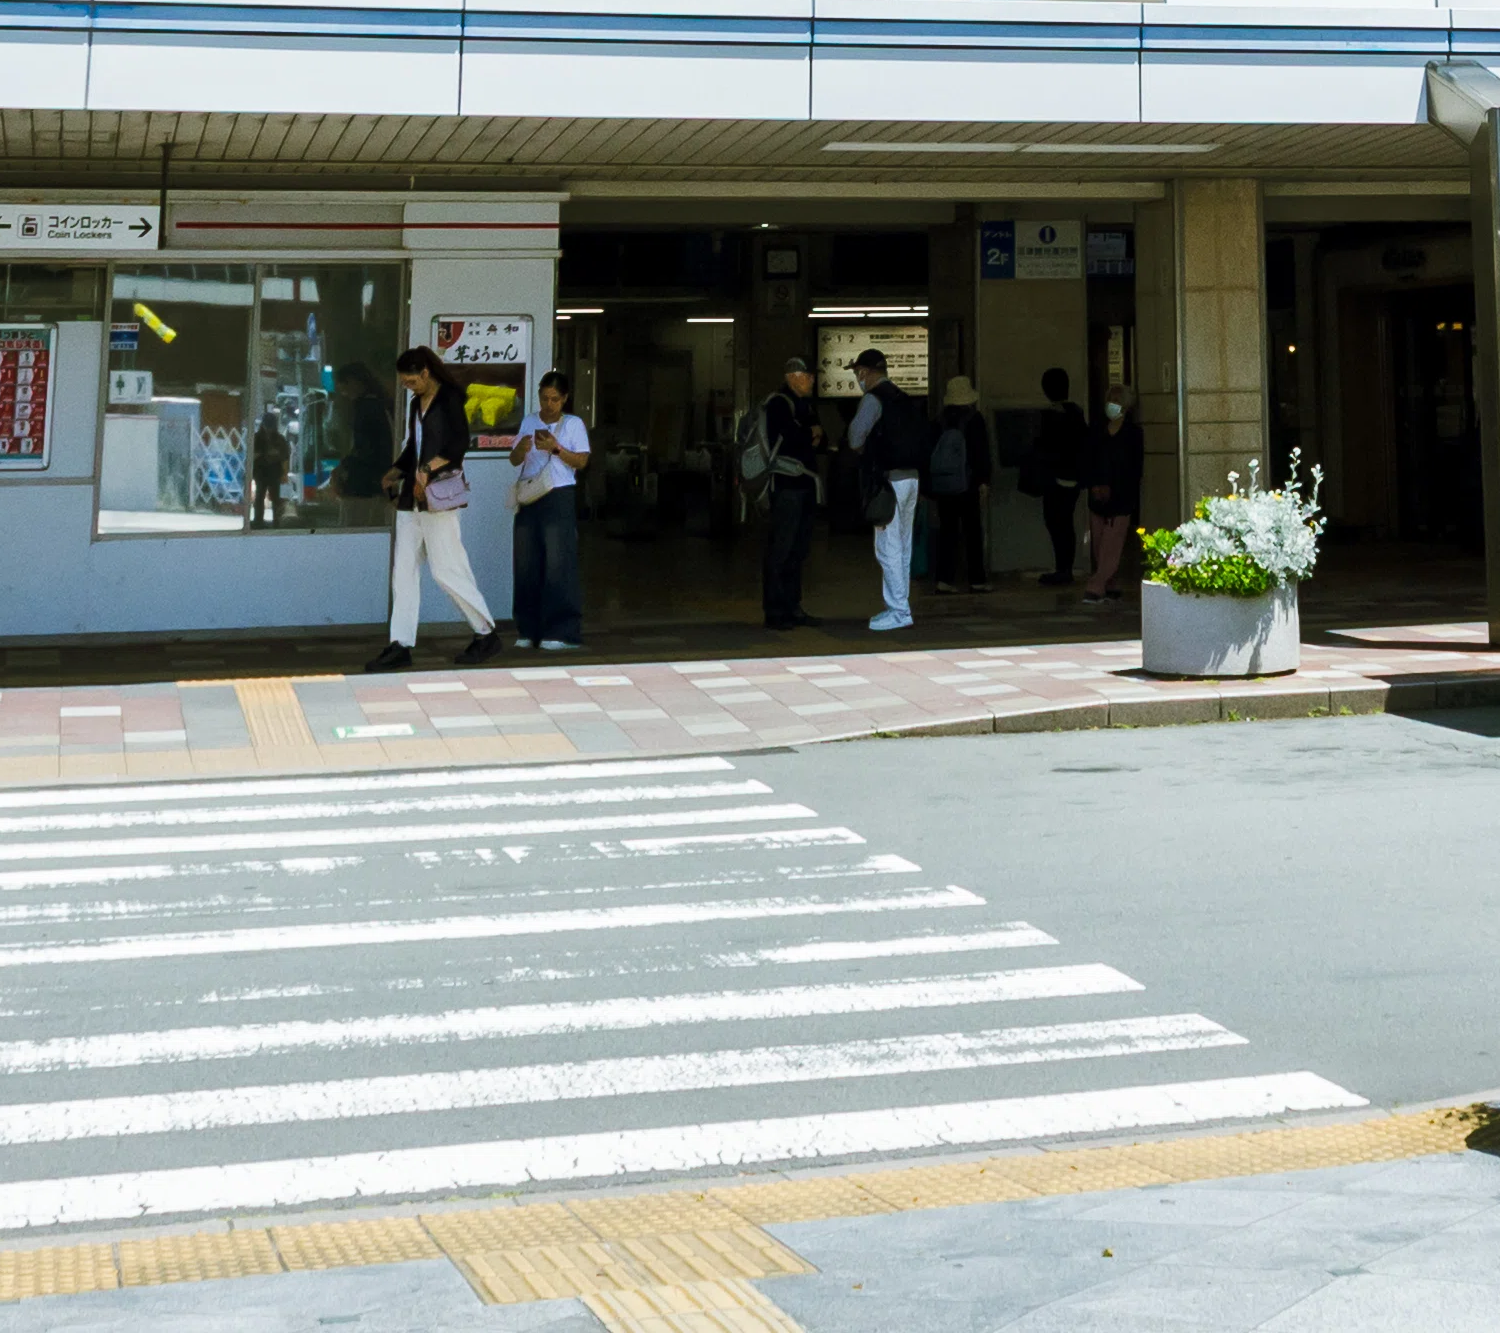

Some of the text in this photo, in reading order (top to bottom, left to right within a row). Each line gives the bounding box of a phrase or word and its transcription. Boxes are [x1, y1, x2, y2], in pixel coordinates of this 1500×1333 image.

[48, 215, 123, 230] コインロッカー
[47, 230, 112, 240] Coin Lockers
[987, 248, 1009, 265] 2F
